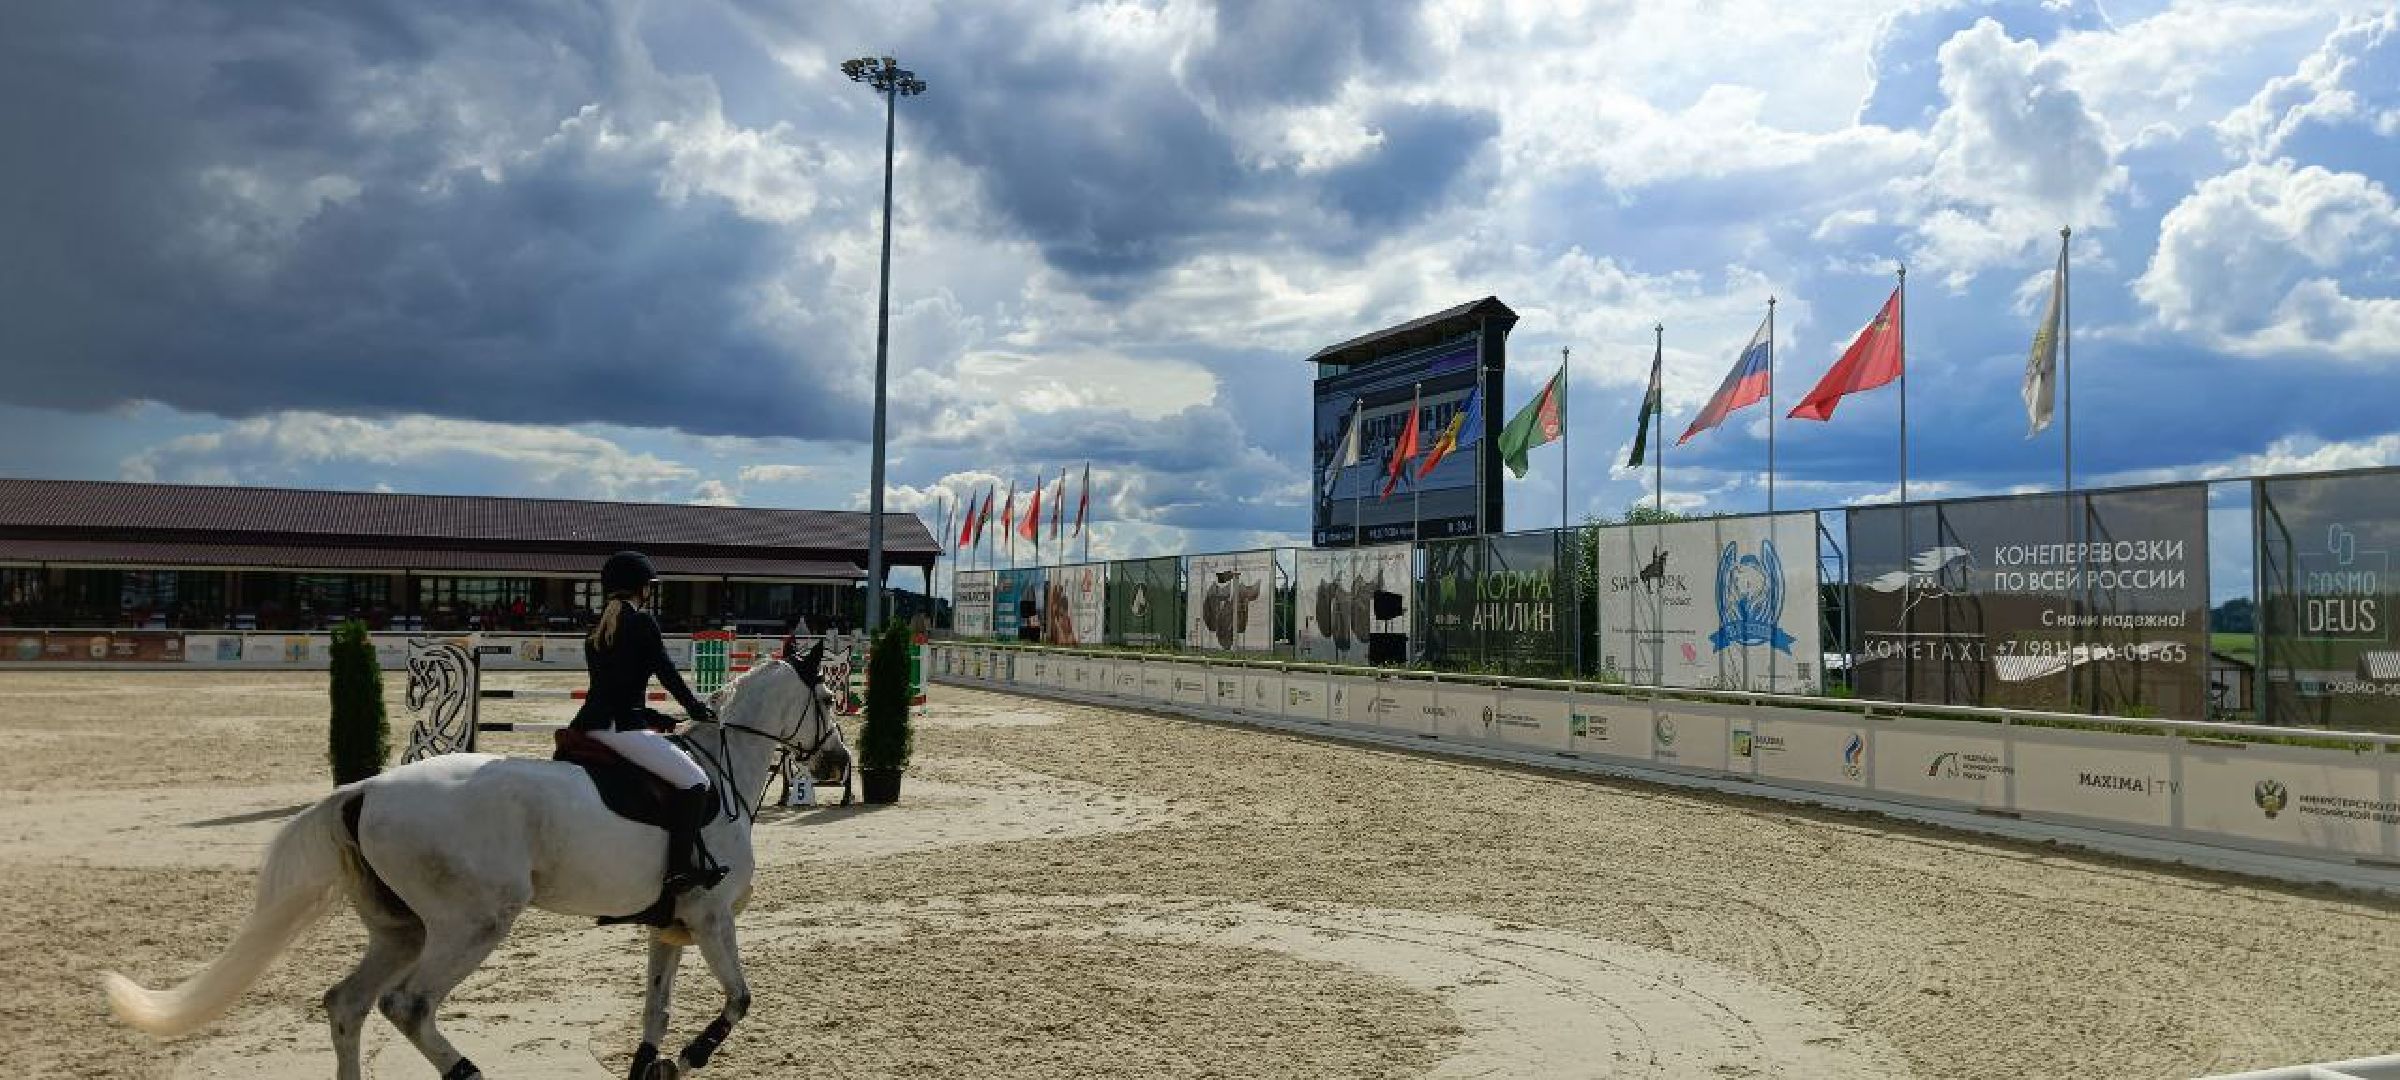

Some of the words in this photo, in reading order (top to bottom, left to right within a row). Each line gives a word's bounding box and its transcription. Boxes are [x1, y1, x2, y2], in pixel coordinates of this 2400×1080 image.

[1994, 540, 2184, 566] КОНЕПЕРЕВОЗКИ
[1995, 573, 2024, 591] ПО
[2029, 568, 2081, 591] ВСЕЙ
[2087, 569, 2186, 590] РОССИИ
[2307, 571, 2376, 596] COSMO
[1472, 602, 1554, 632] АНИЛИН
[2042, 610, 2053, 626] С
[2308, 599, 2376, 632] DEUS
[1863, 640, 1988, 662] KONETAXI
[797, 782, 805, 799] 5
[2079, 772, 2144, 792] MAXIMA
